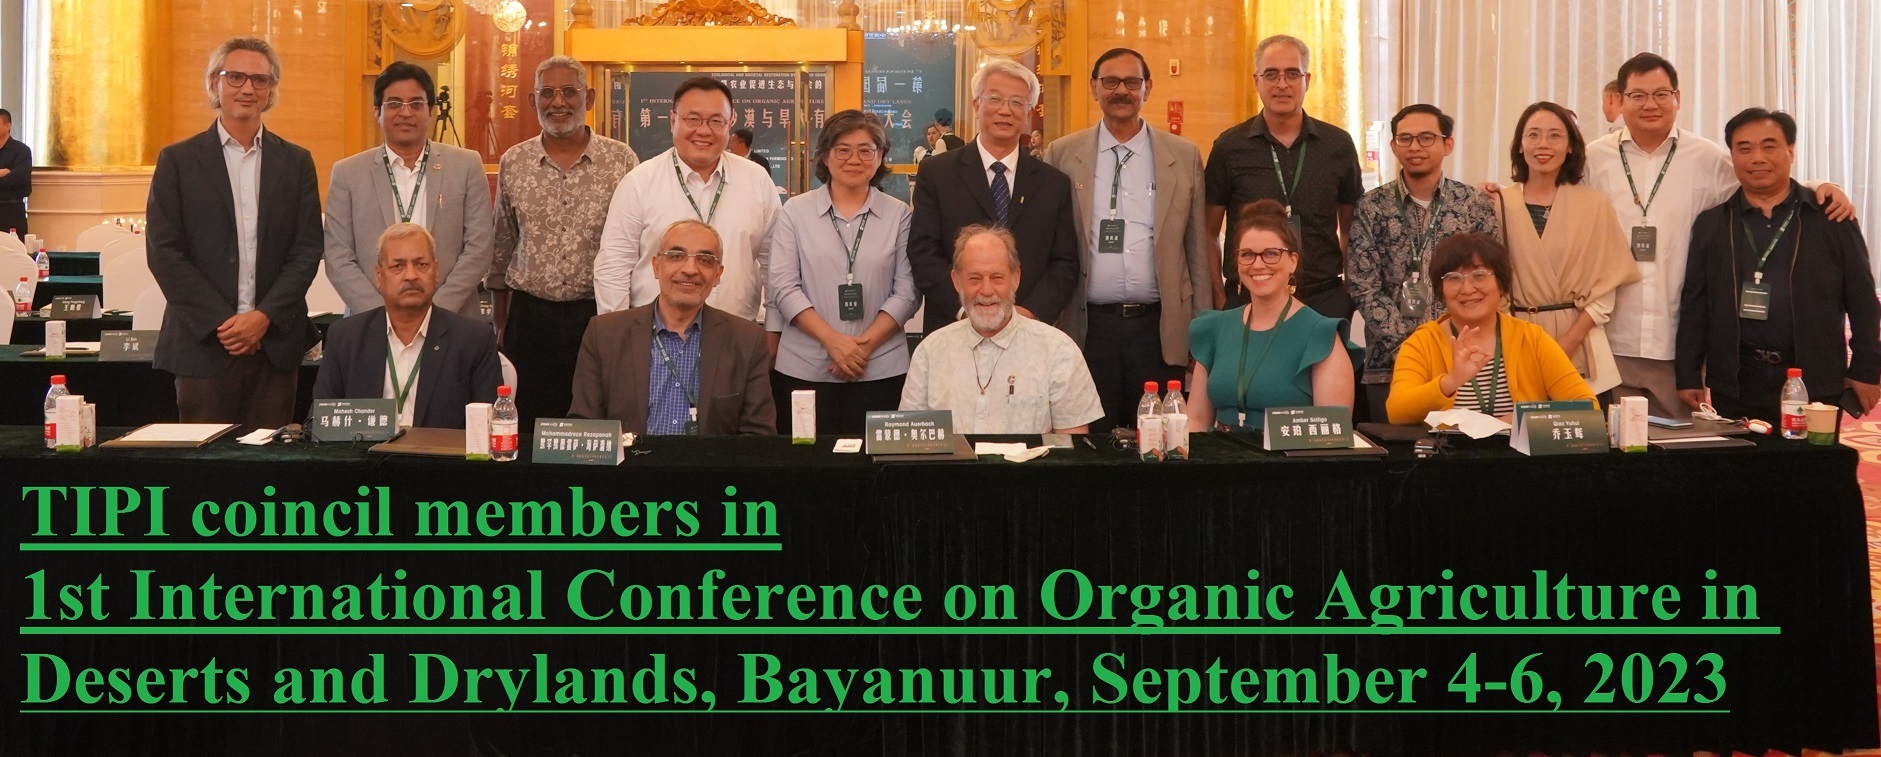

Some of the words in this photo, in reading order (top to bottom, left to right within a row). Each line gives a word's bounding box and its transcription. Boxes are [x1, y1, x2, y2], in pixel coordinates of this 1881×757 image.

[501, 43, 518, 119] 锦绣河套
[884, 110, 911, 128] 大会
[1552, 428, 1584, 440] 乔玉辉
